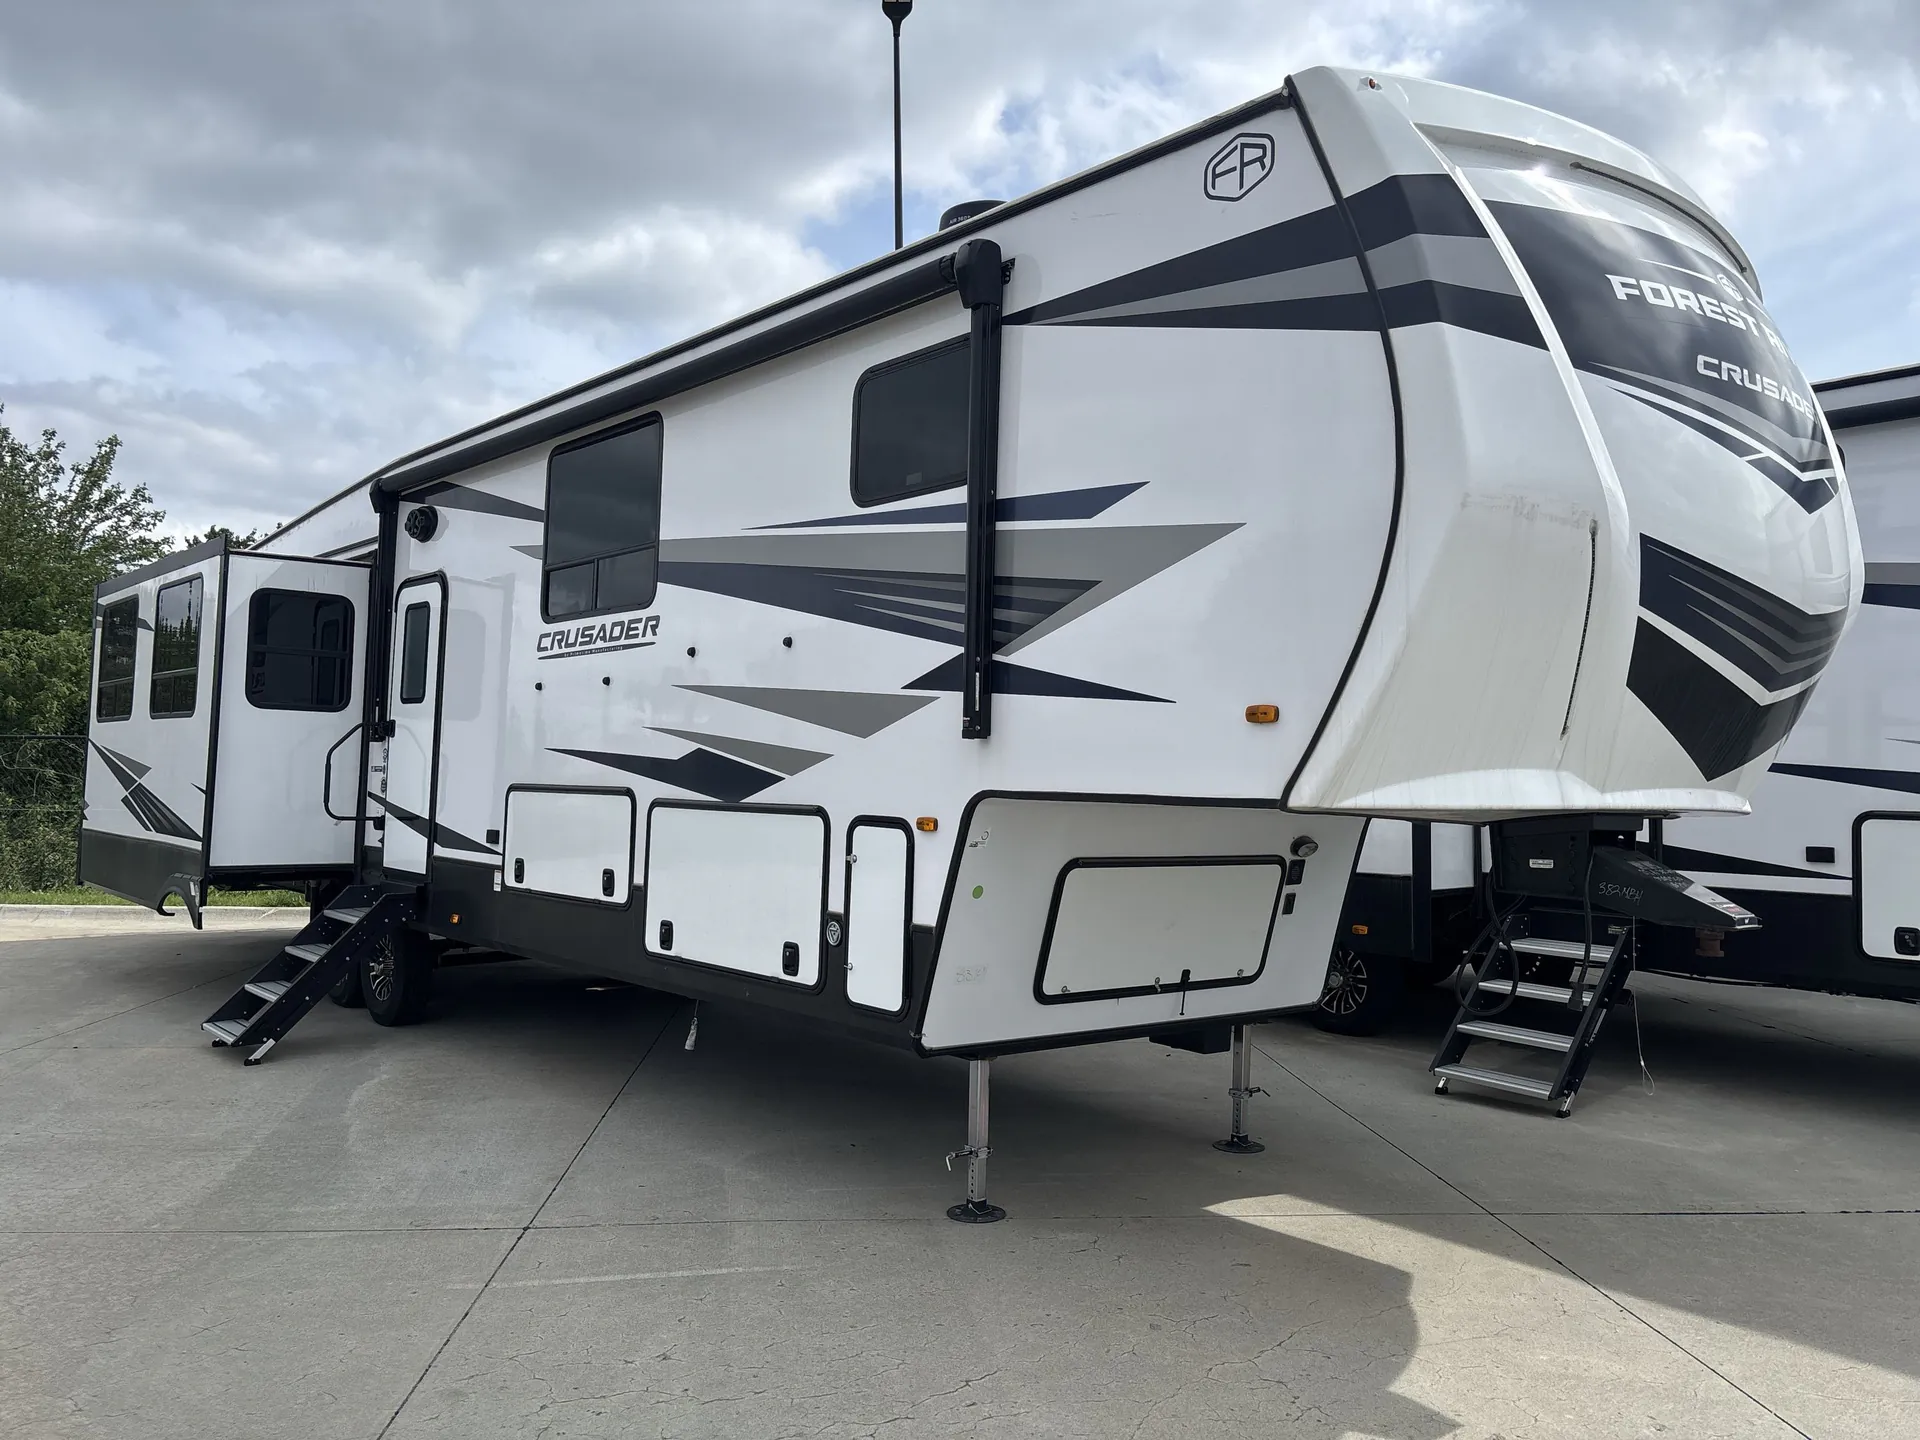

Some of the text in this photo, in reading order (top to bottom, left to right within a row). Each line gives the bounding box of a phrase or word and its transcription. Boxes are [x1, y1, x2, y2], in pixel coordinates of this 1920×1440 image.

[1605, 274, 1759, 337] FOREST
[1697, 354, 1819, 425] CRUSADE
[537, 615, 660, 652] CRUSADER
